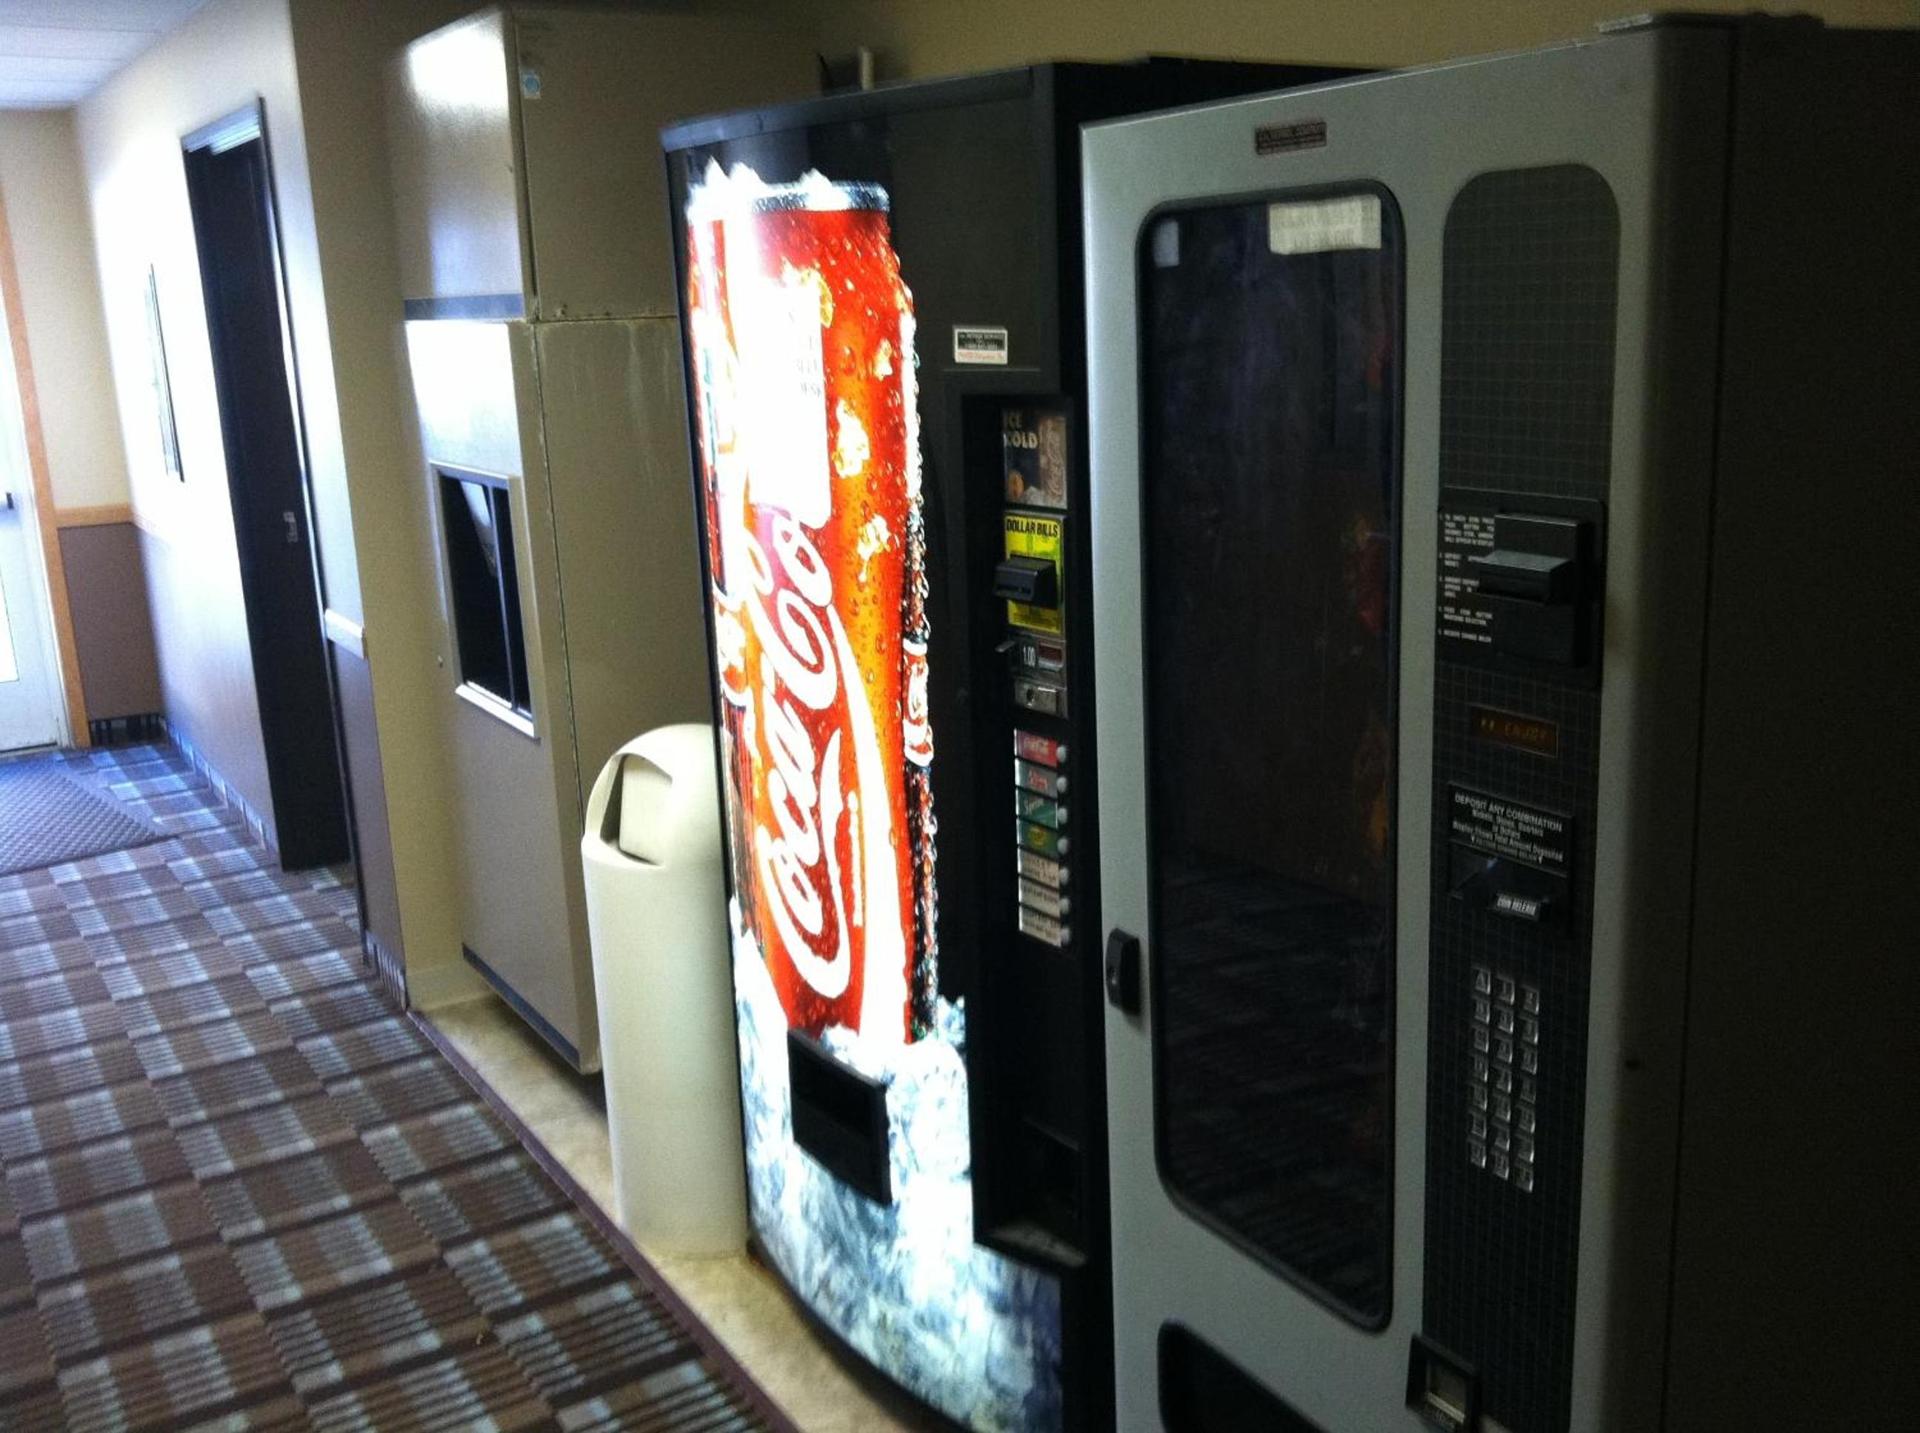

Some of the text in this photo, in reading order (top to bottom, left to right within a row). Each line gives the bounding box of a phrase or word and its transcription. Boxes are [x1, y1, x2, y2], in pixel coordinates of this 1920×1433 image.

[1006, 517, 1058, 538] DOLLAR BILLS
[1455, 792, 1562, 832] DEPOSIT ANY COMBINATION
